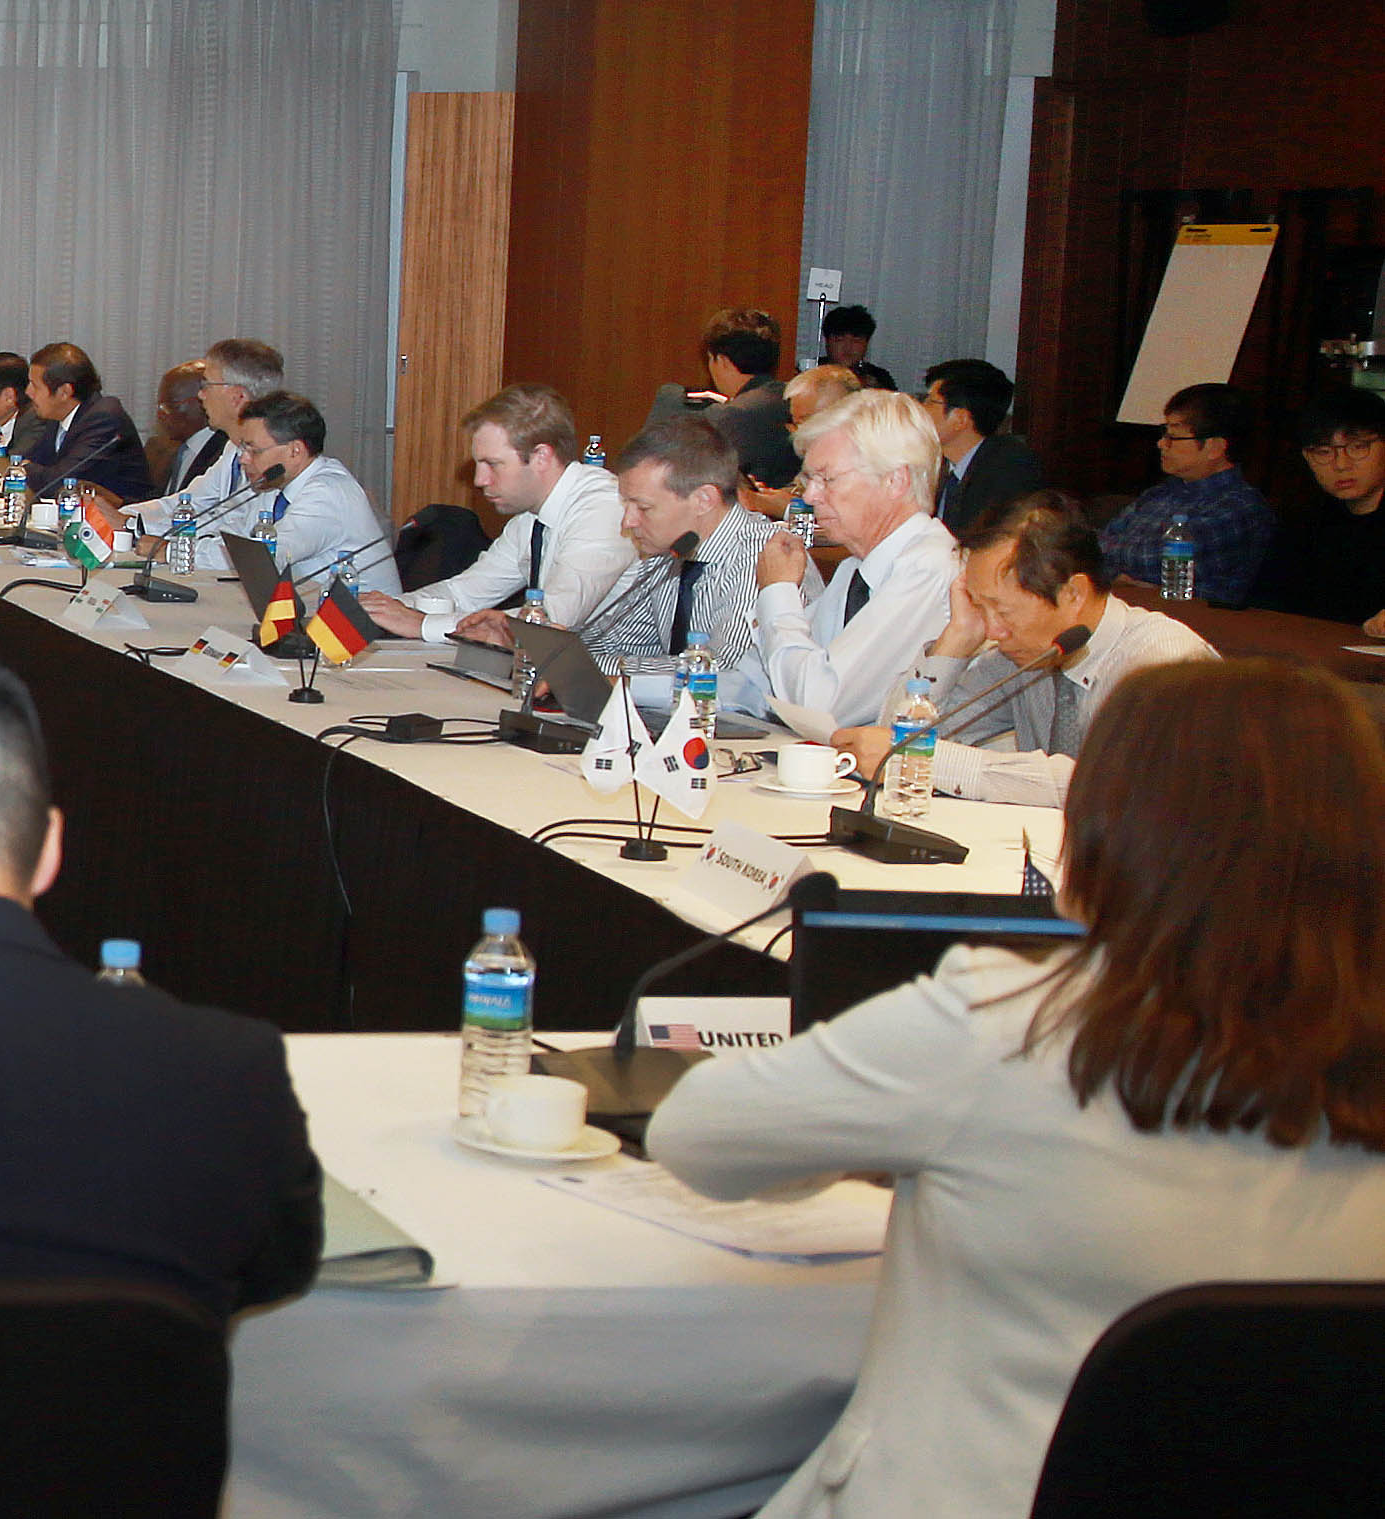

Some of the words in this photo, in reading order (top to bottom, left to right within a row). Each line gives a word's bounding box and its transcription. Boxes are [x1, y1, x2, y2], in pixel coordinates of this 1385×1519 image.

[715, 851, 741, 873] SOUTH
[741, 863, 768, 884] KOREA
[697, 1030, 784, 1048] UNITED
